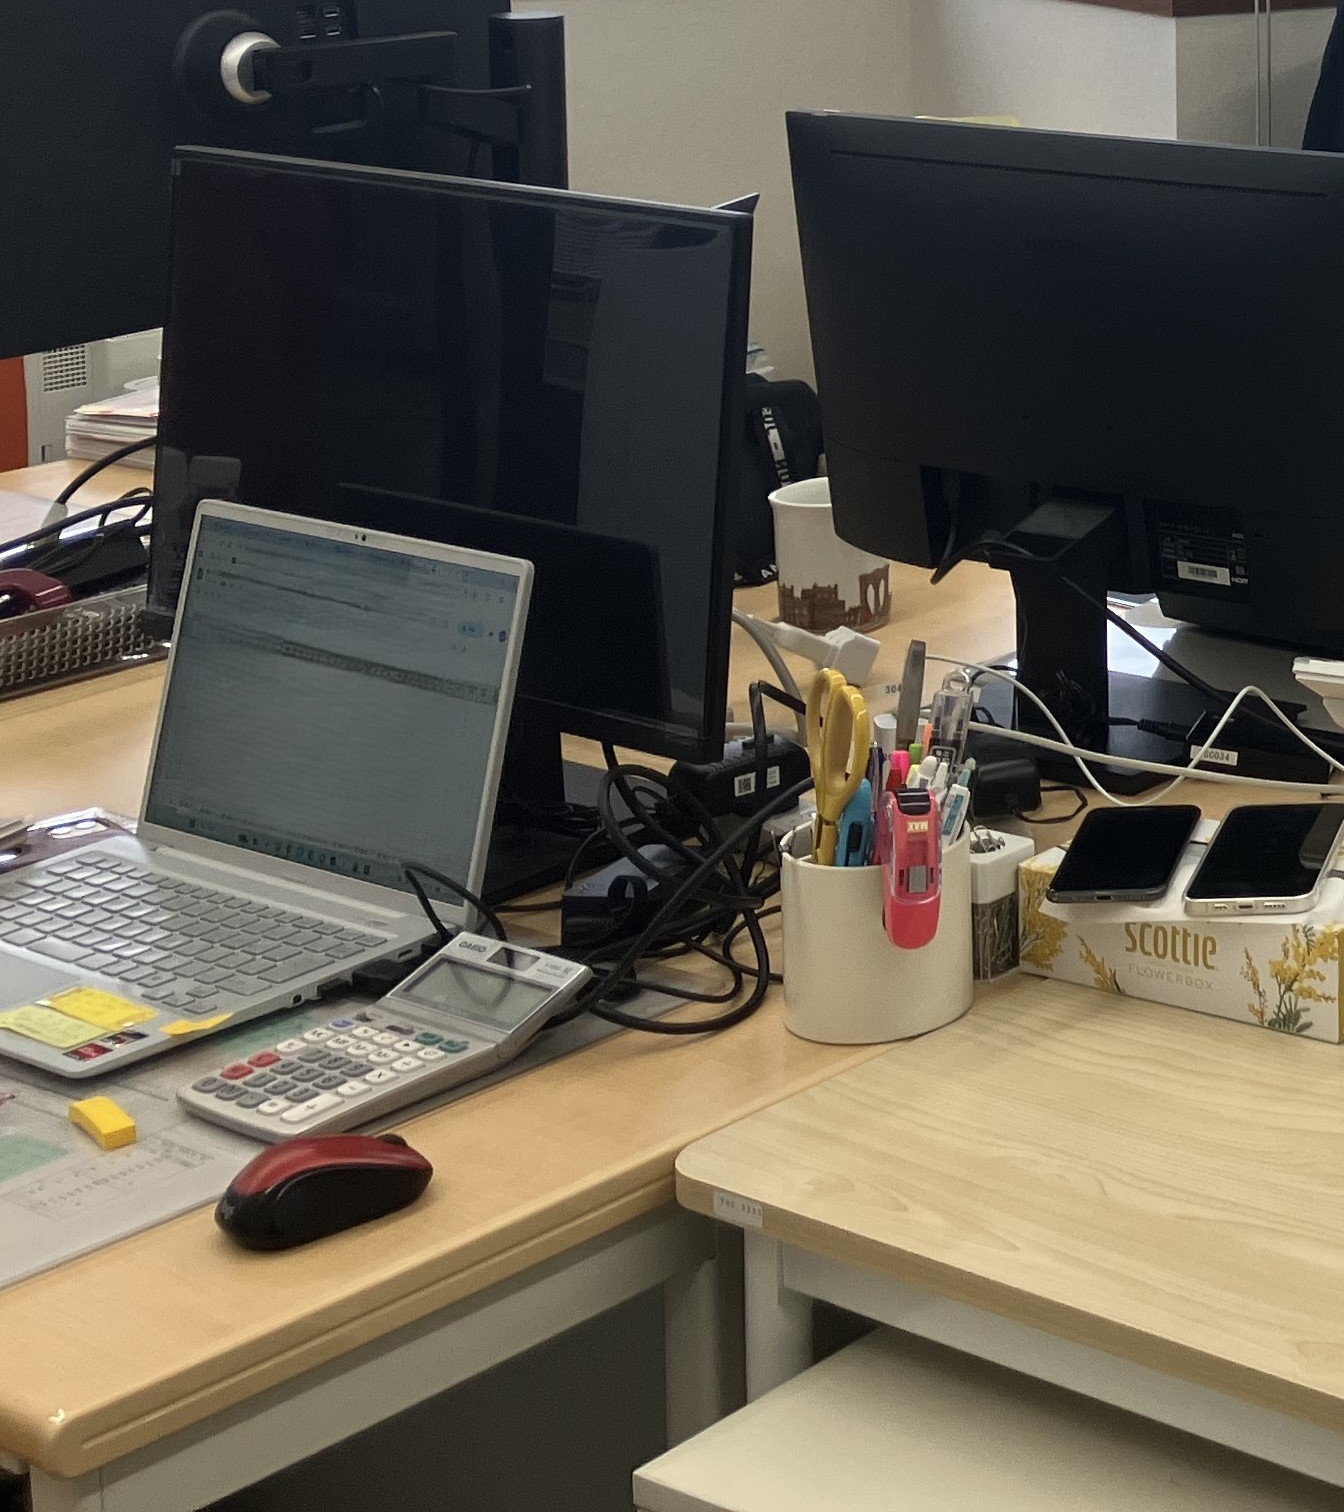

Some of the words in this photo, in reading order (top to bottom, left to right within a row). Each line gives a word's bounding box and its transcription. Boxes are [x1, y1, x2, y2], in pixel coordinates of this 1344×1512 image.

[906, 821, 929, 833] MAX
[458, 941, 487, 953] CASIO
[1124, 922, 1218, 971] scottie
[1127, 962, 1214, 991] FLOWERBOX
